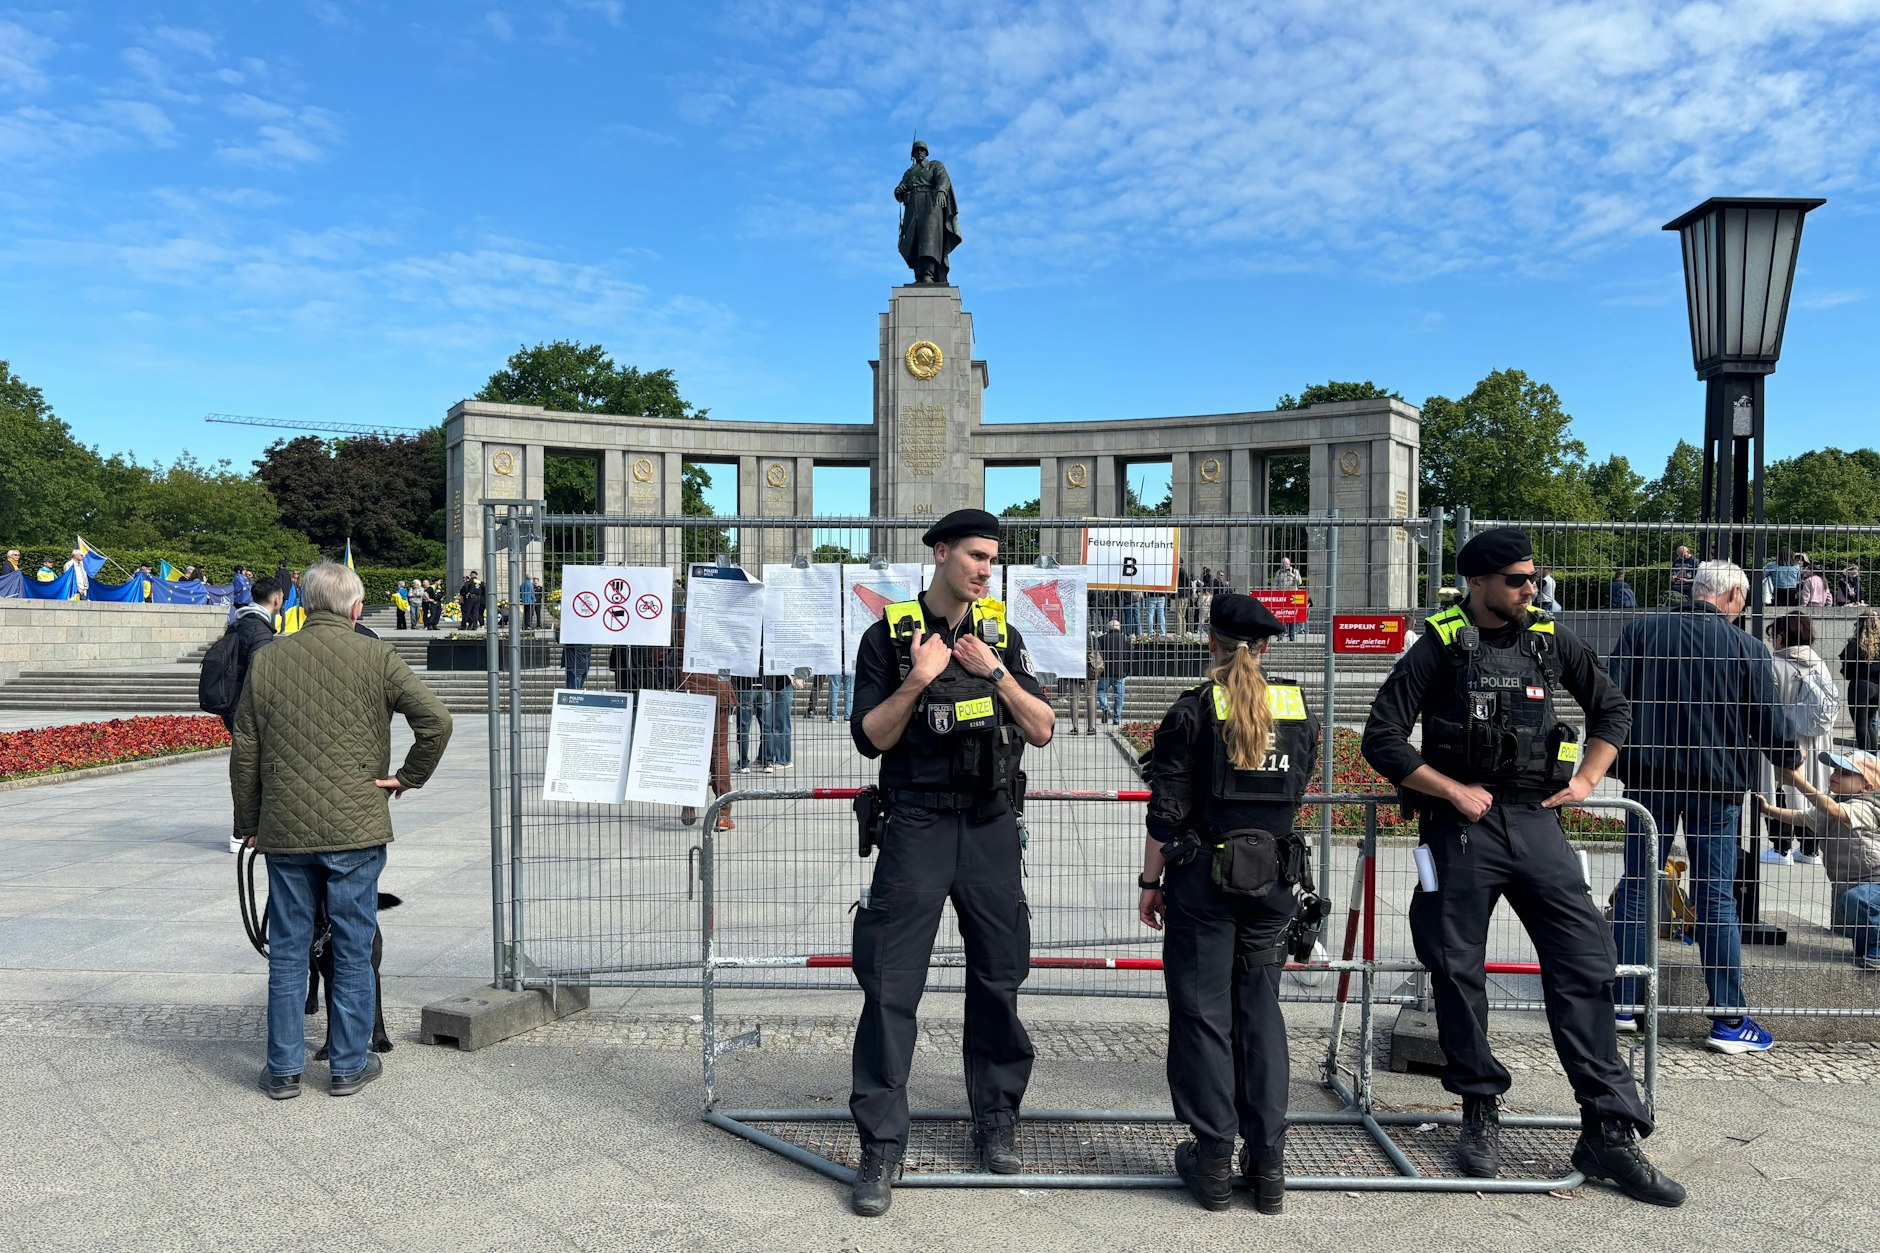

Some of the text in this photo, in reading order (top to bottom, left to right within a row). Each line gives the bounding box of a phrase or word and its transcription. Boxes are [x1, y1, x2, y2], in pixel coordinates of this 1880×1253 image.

[913, 503, 933, 513] 1941
[1088, 537, 1174, 549] Feuerwehrzufahrt
[1122, 557, 1138, 577] B
[1480, 676, 1520, 688] POLIZEI
[958, 700, 992, 717] POLIZEI
